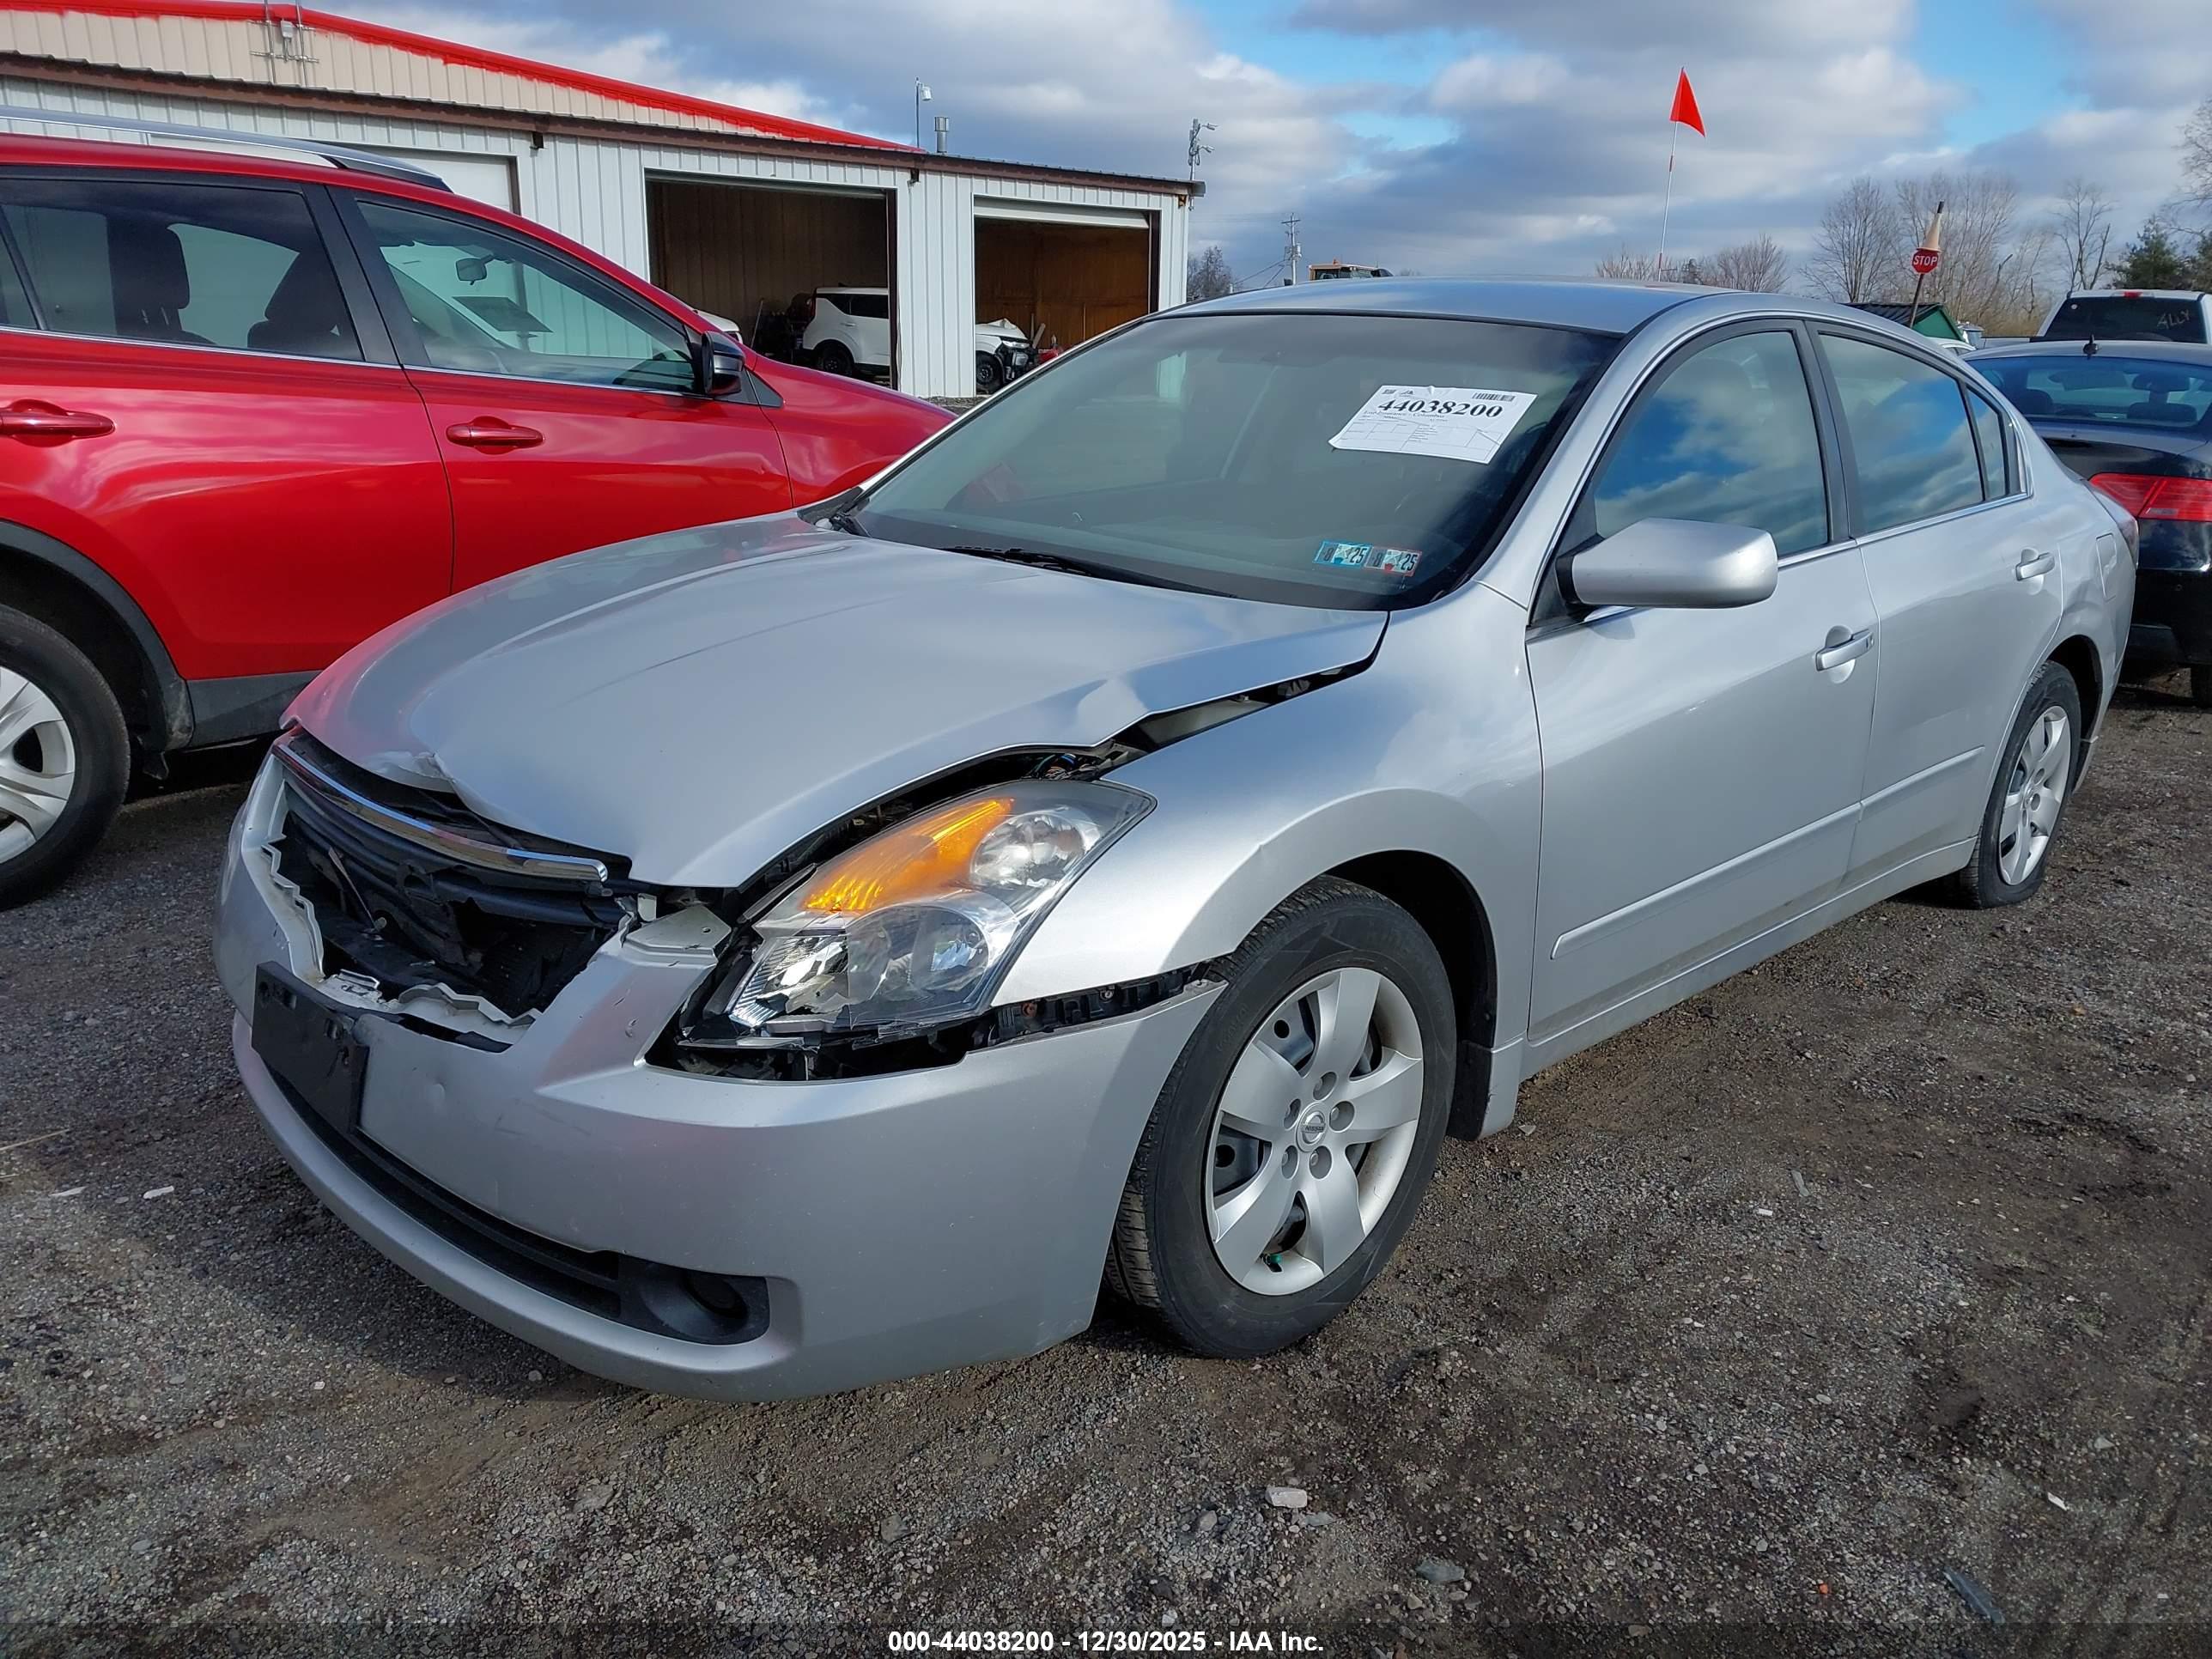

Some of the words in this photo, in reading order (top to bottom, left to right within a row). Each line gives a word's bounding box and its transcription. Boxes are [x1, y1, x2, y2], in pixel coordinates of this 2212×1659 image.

[1913, 255, 1938, 266] STOP
[1378, 399, 1503, 418] 44038200
[1349, 547, 1368, 564] 25
[1401, 553, 1418, 571] 25
